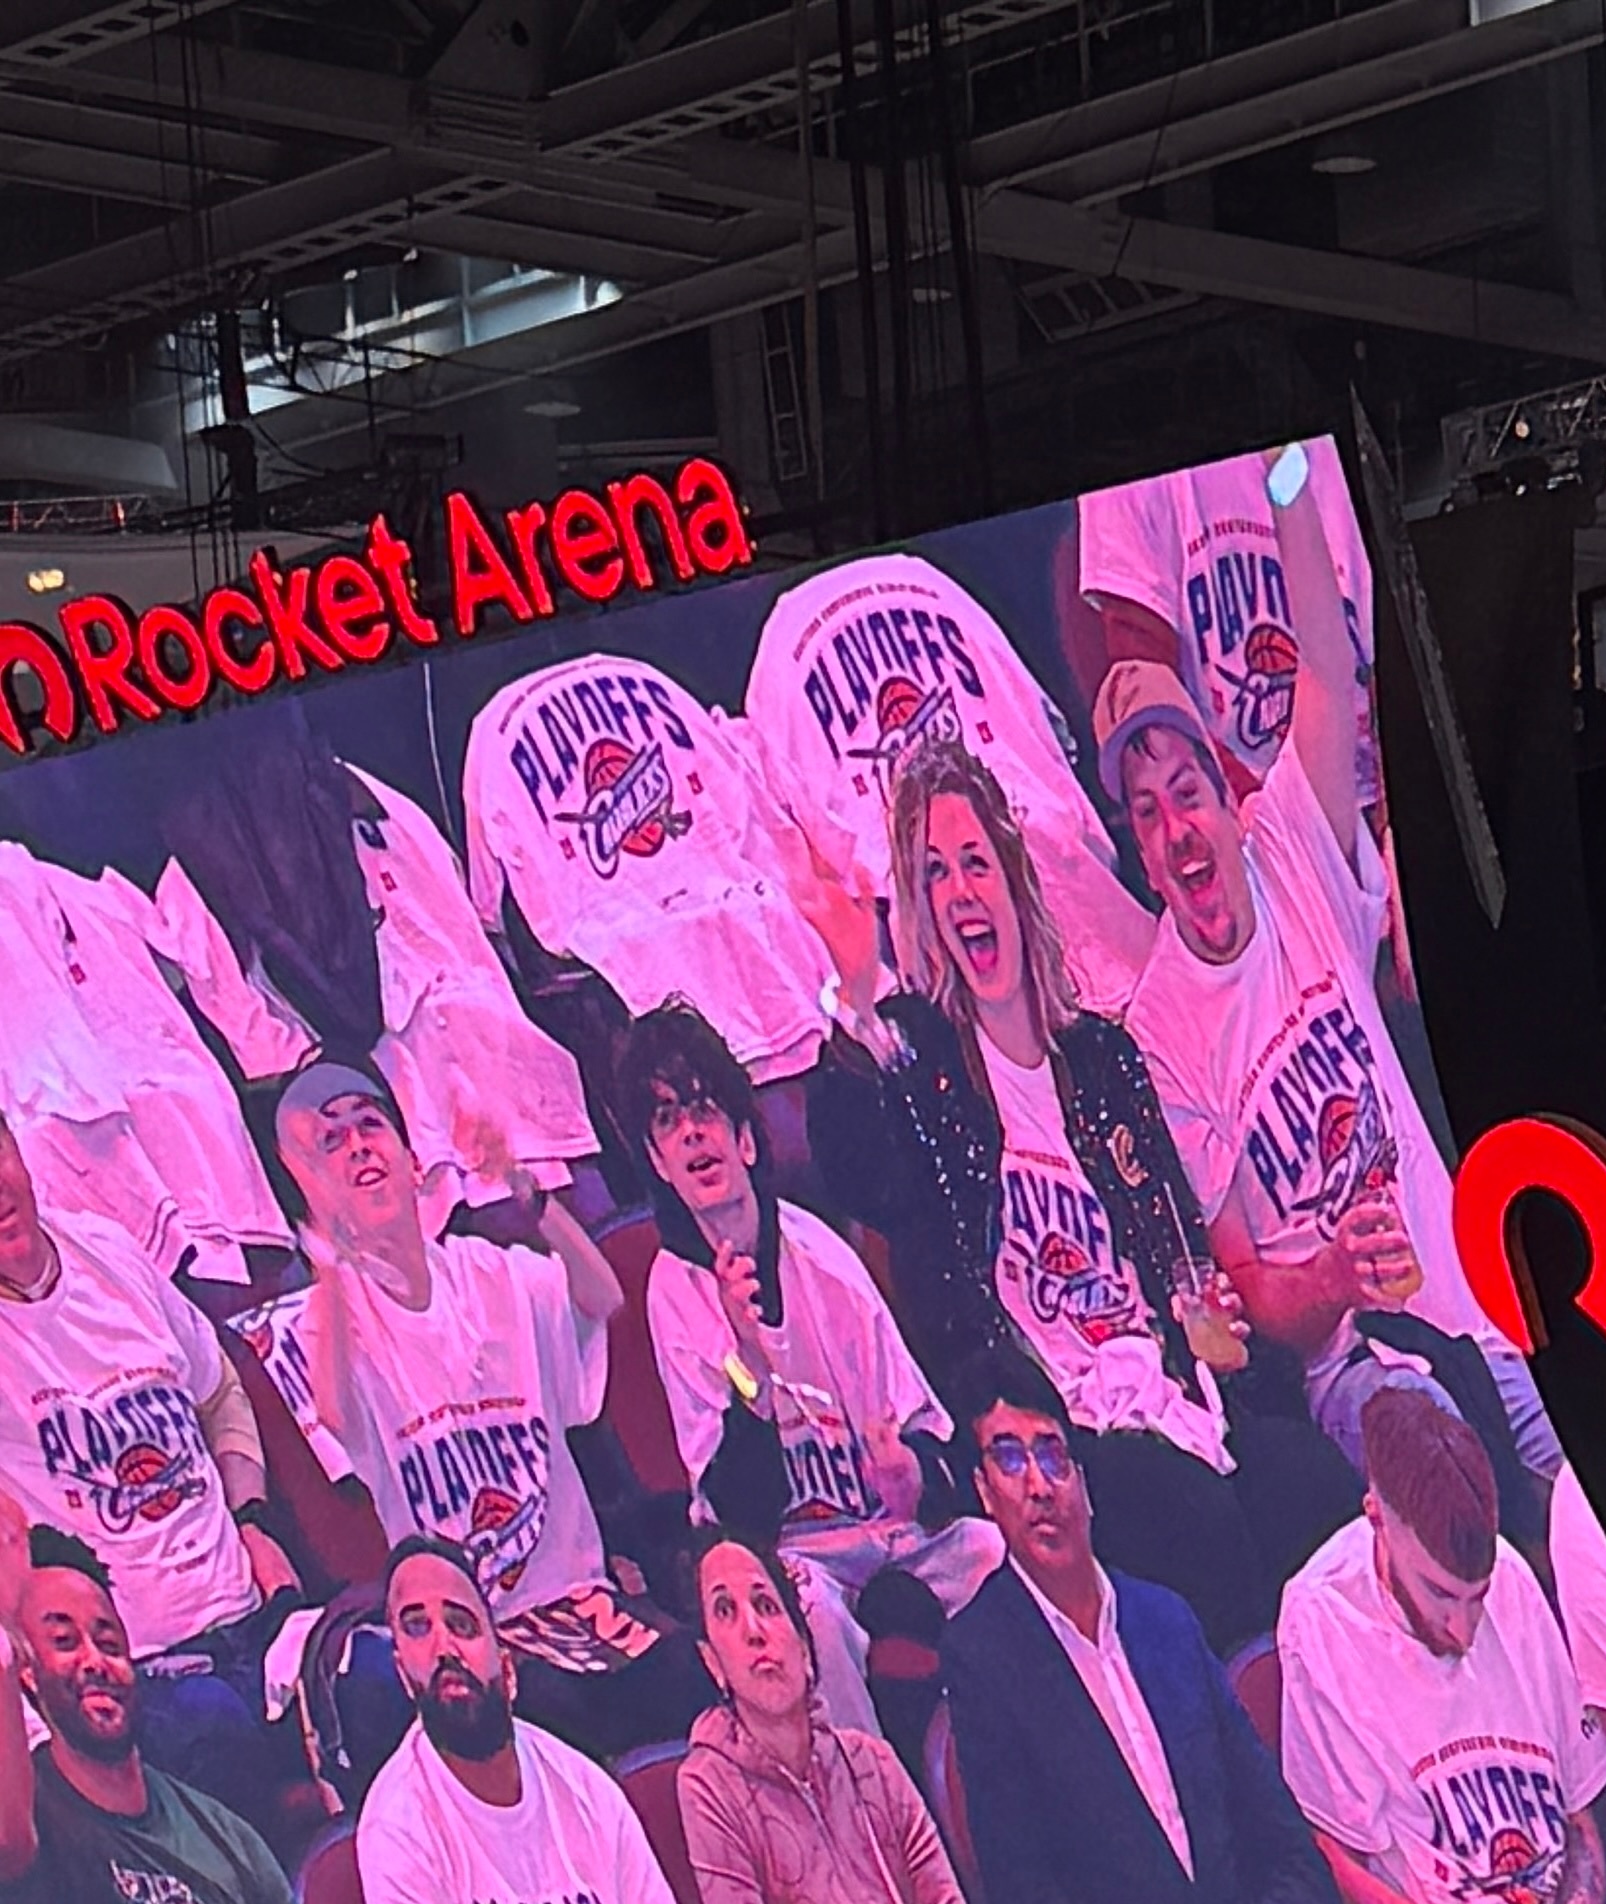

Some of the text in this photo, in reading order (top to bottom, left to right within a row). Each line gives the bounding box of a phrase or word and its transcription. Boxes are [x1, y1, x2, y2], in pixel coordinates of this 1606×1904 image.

[58, 513, 441, 733] Rocket
[446, 456, 753, 637] Arena
[510, 675, 696, 828] PLAYOFFS
[803, 608, 985, 760] PLAYOFFS
[399, 1415, 550, 1530] PLAYOFFS
